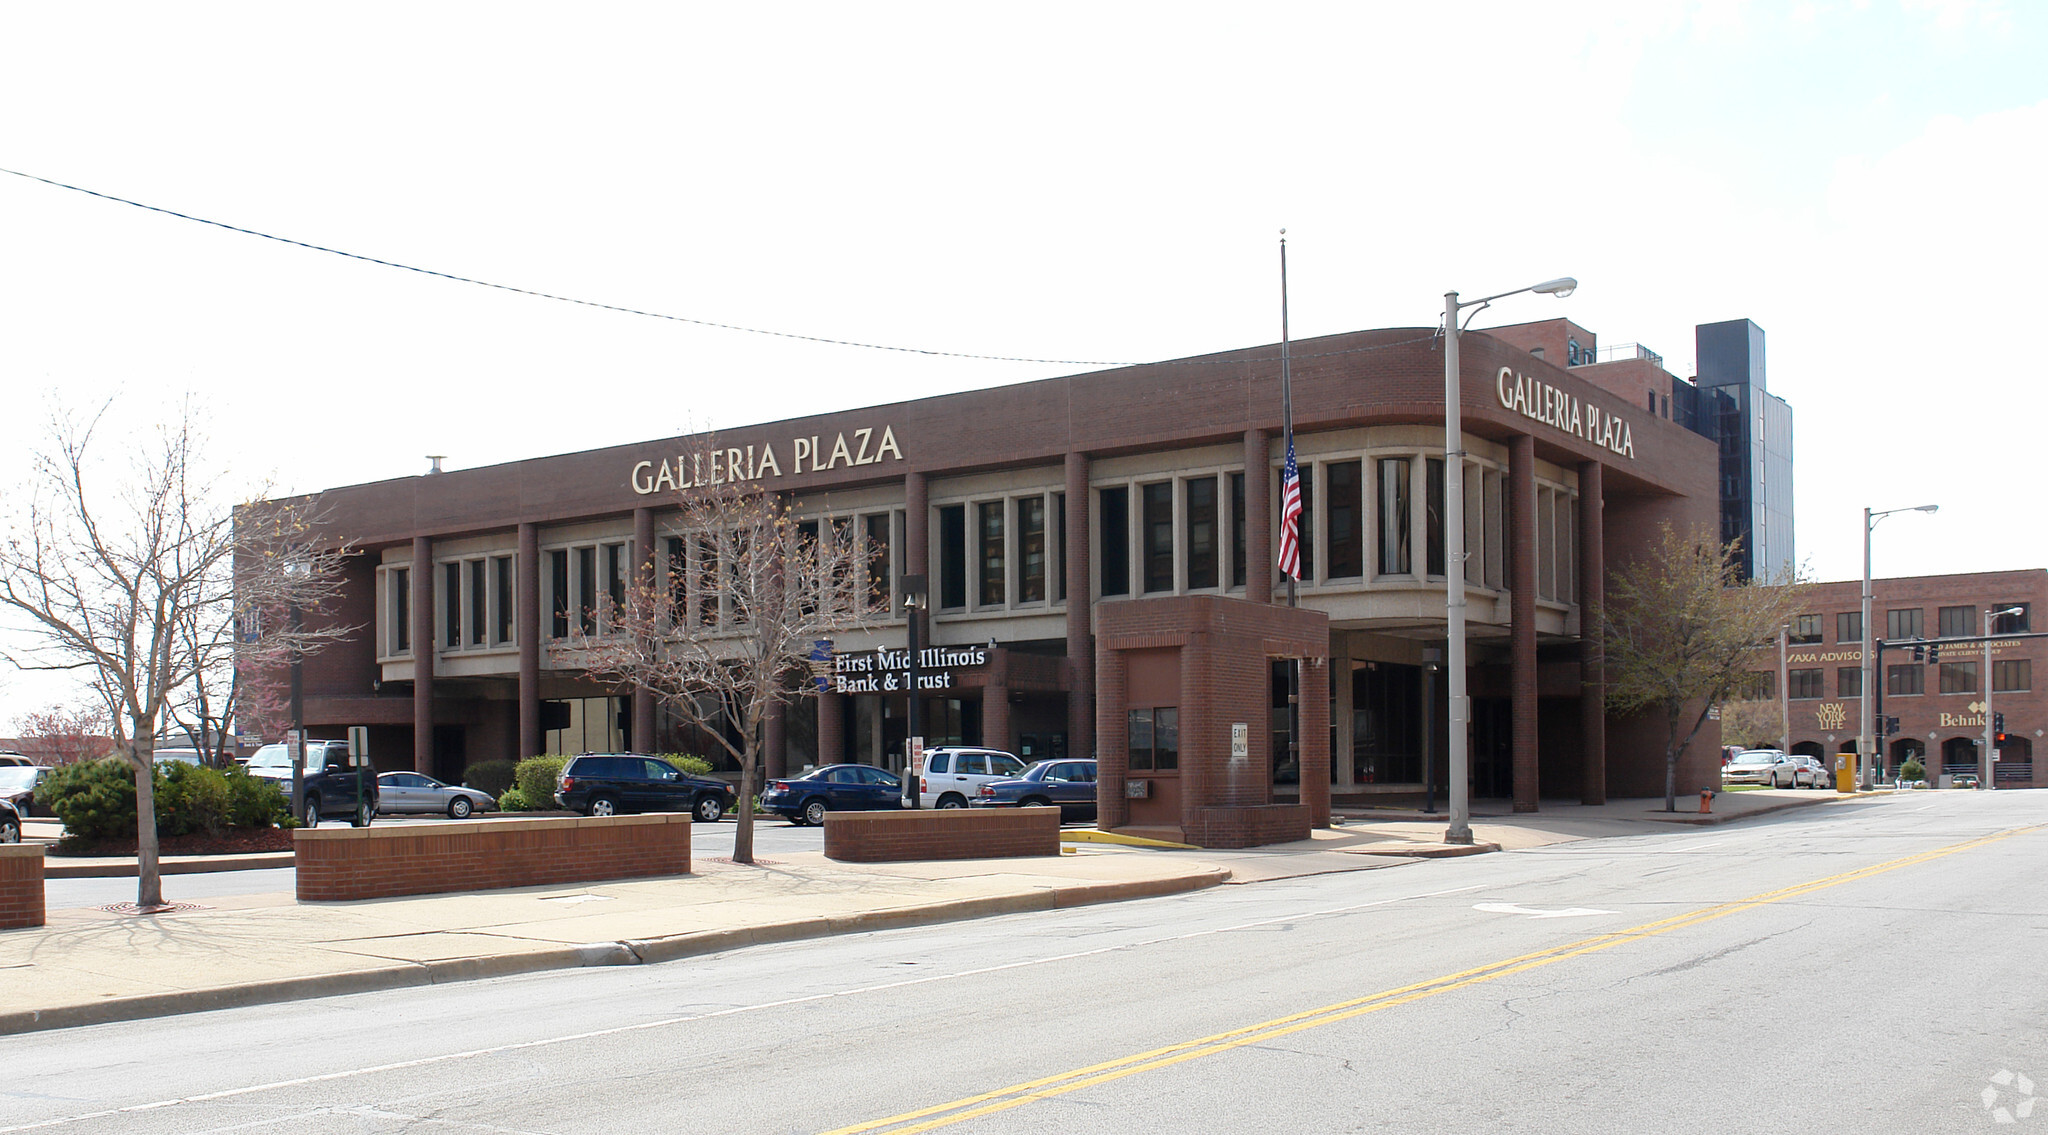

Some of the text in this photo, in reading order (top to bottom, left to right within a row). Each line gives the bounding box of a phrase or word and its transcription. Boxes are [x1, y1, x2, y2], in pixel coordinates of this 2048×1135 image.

[1496, 366, 1635, 460] GALLERIA PLAZA
[631, 424, 903, 495] GALLERIA PLAZA
[1945, 642, 1969, 650] JAMES
[1970, 641, 1977, 649] &
[1978, 640, 2022, 649] ASOCIATES
[1794, 650, 1876, 663] AXA ADVISOS
[1980, 648, 2002, 656] GUP
[835, 653, 873, 672] First
[836, 671, 951, 693] Bank & Trust
[1820, 703, 1844, 713] NEW
[1816, 711, 1847, 722] YORK
[1820, 720, 1844, 730] LIFE
[1233, 728, 1246, 738] EXIT
[1233, 742, 1246, 752] ONLY
